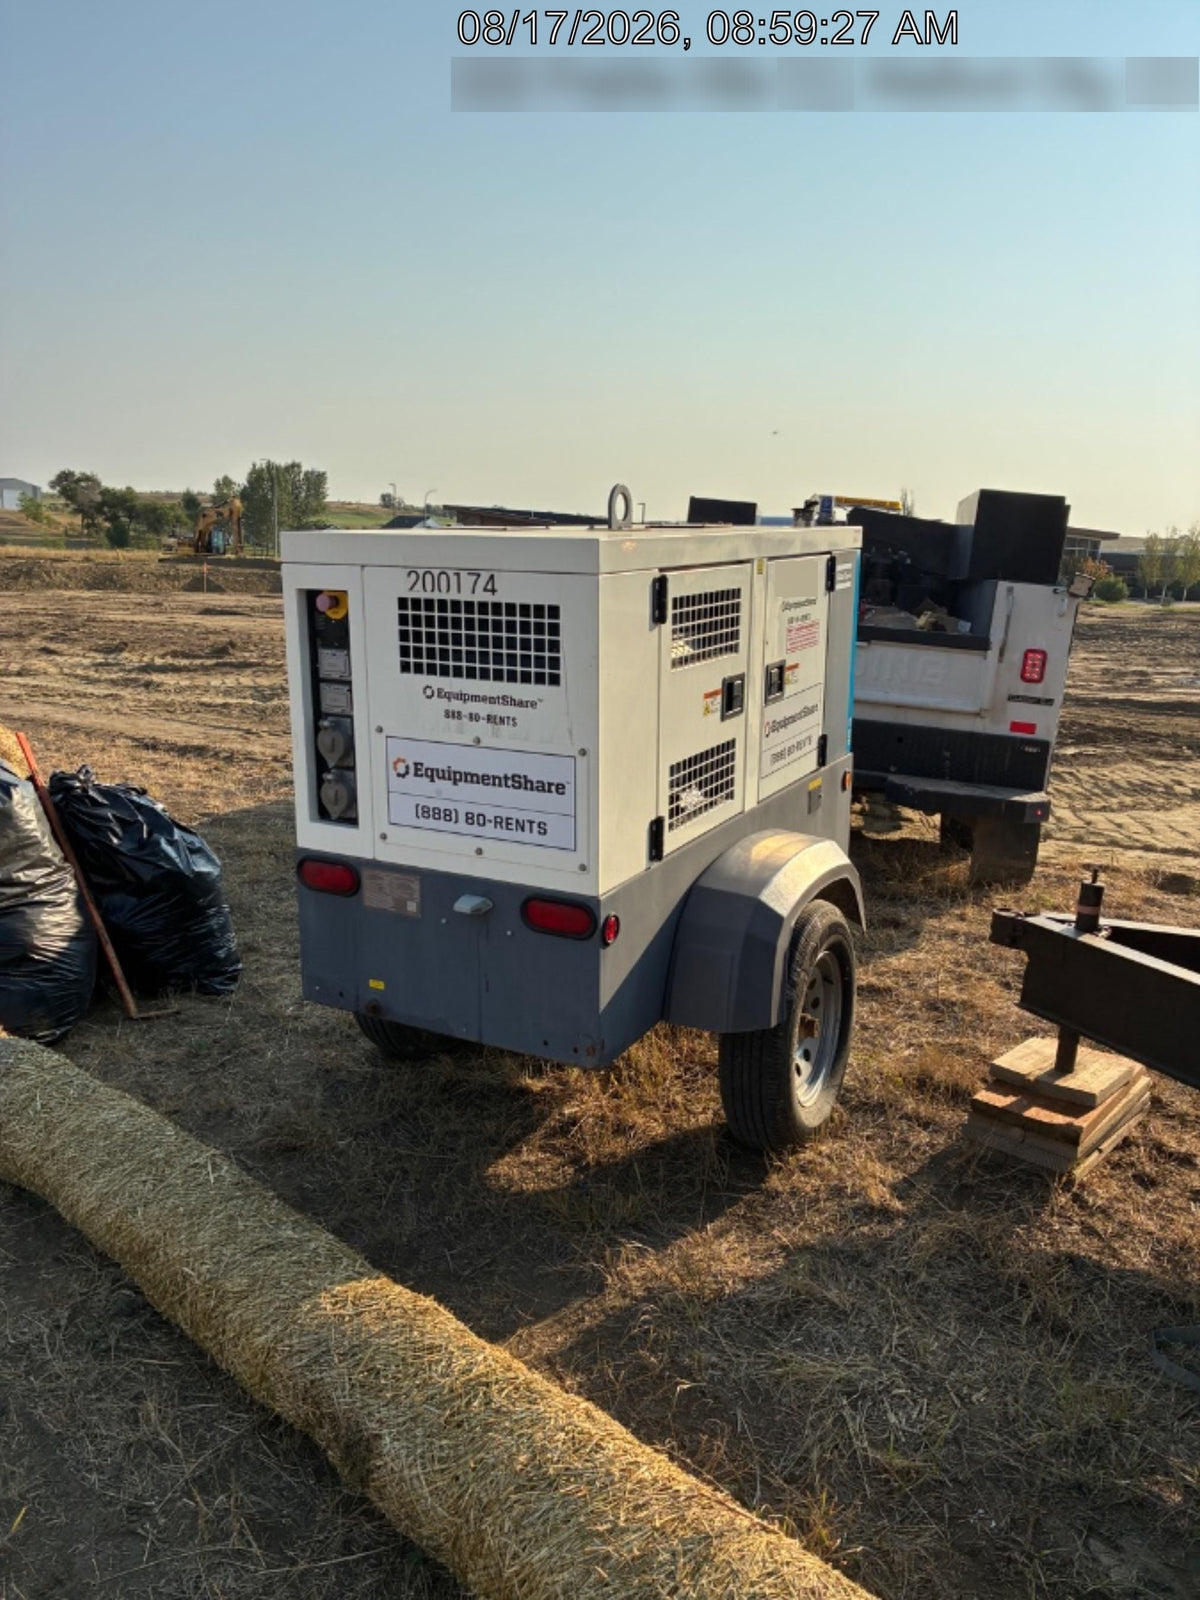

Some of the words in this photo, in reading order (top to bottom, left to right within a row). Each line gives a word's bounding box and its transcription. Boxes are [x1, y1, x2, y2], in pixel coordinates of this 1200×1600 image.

[406, 569, 498, 596] 200174
[437, 688, 538, 710] EquipmentShare
[444, 709, 518, 728] 888-80-RENTS
[412, 761, 567, 796] EquipmentShare
[415, 803, 459, 824] (888)
[465, 811, 548, 837] 80-RENTS
